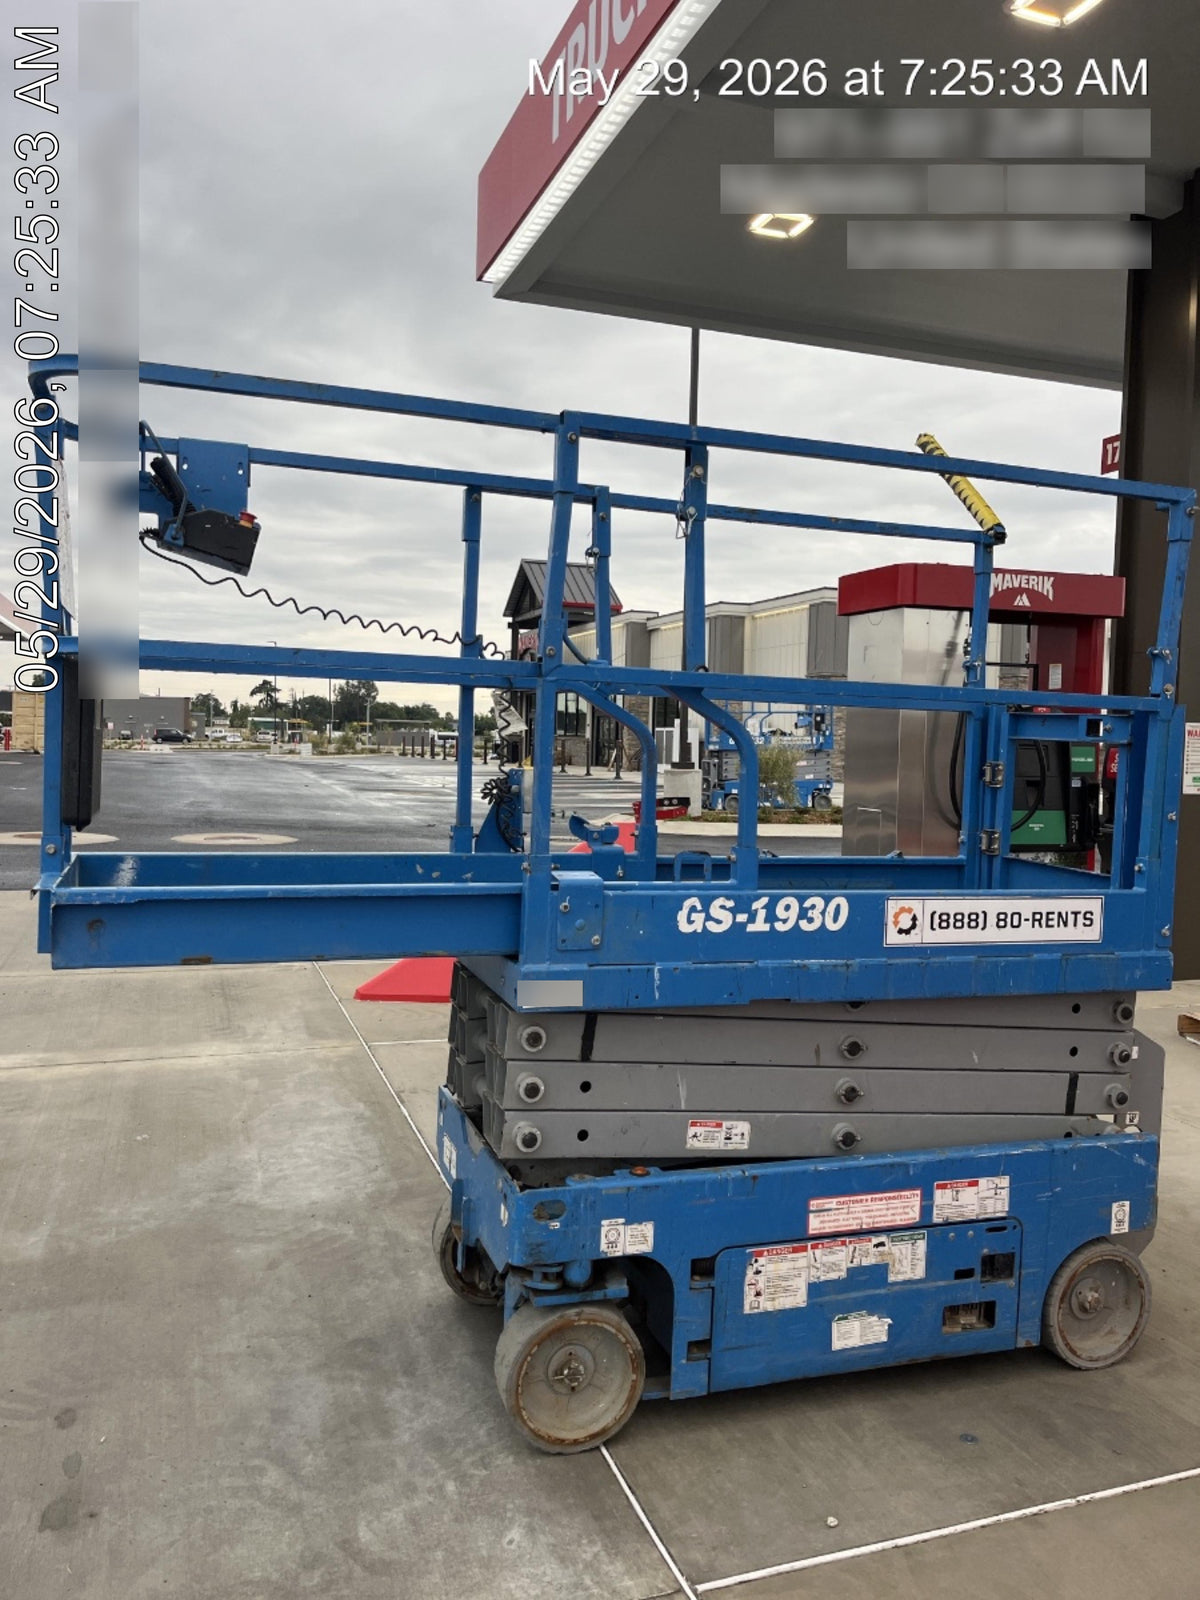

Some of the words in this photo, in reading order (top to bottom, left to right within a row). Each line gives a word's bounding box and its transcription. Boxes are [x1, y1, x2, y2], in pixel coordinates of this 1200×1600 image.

[989, 572, 1055, 601] MAVERIK
[677, 896, 849, 933] GS-1930
[929, 909, 988, 932] (888)
[995, 909, 1095, 931] 80-RENTS
